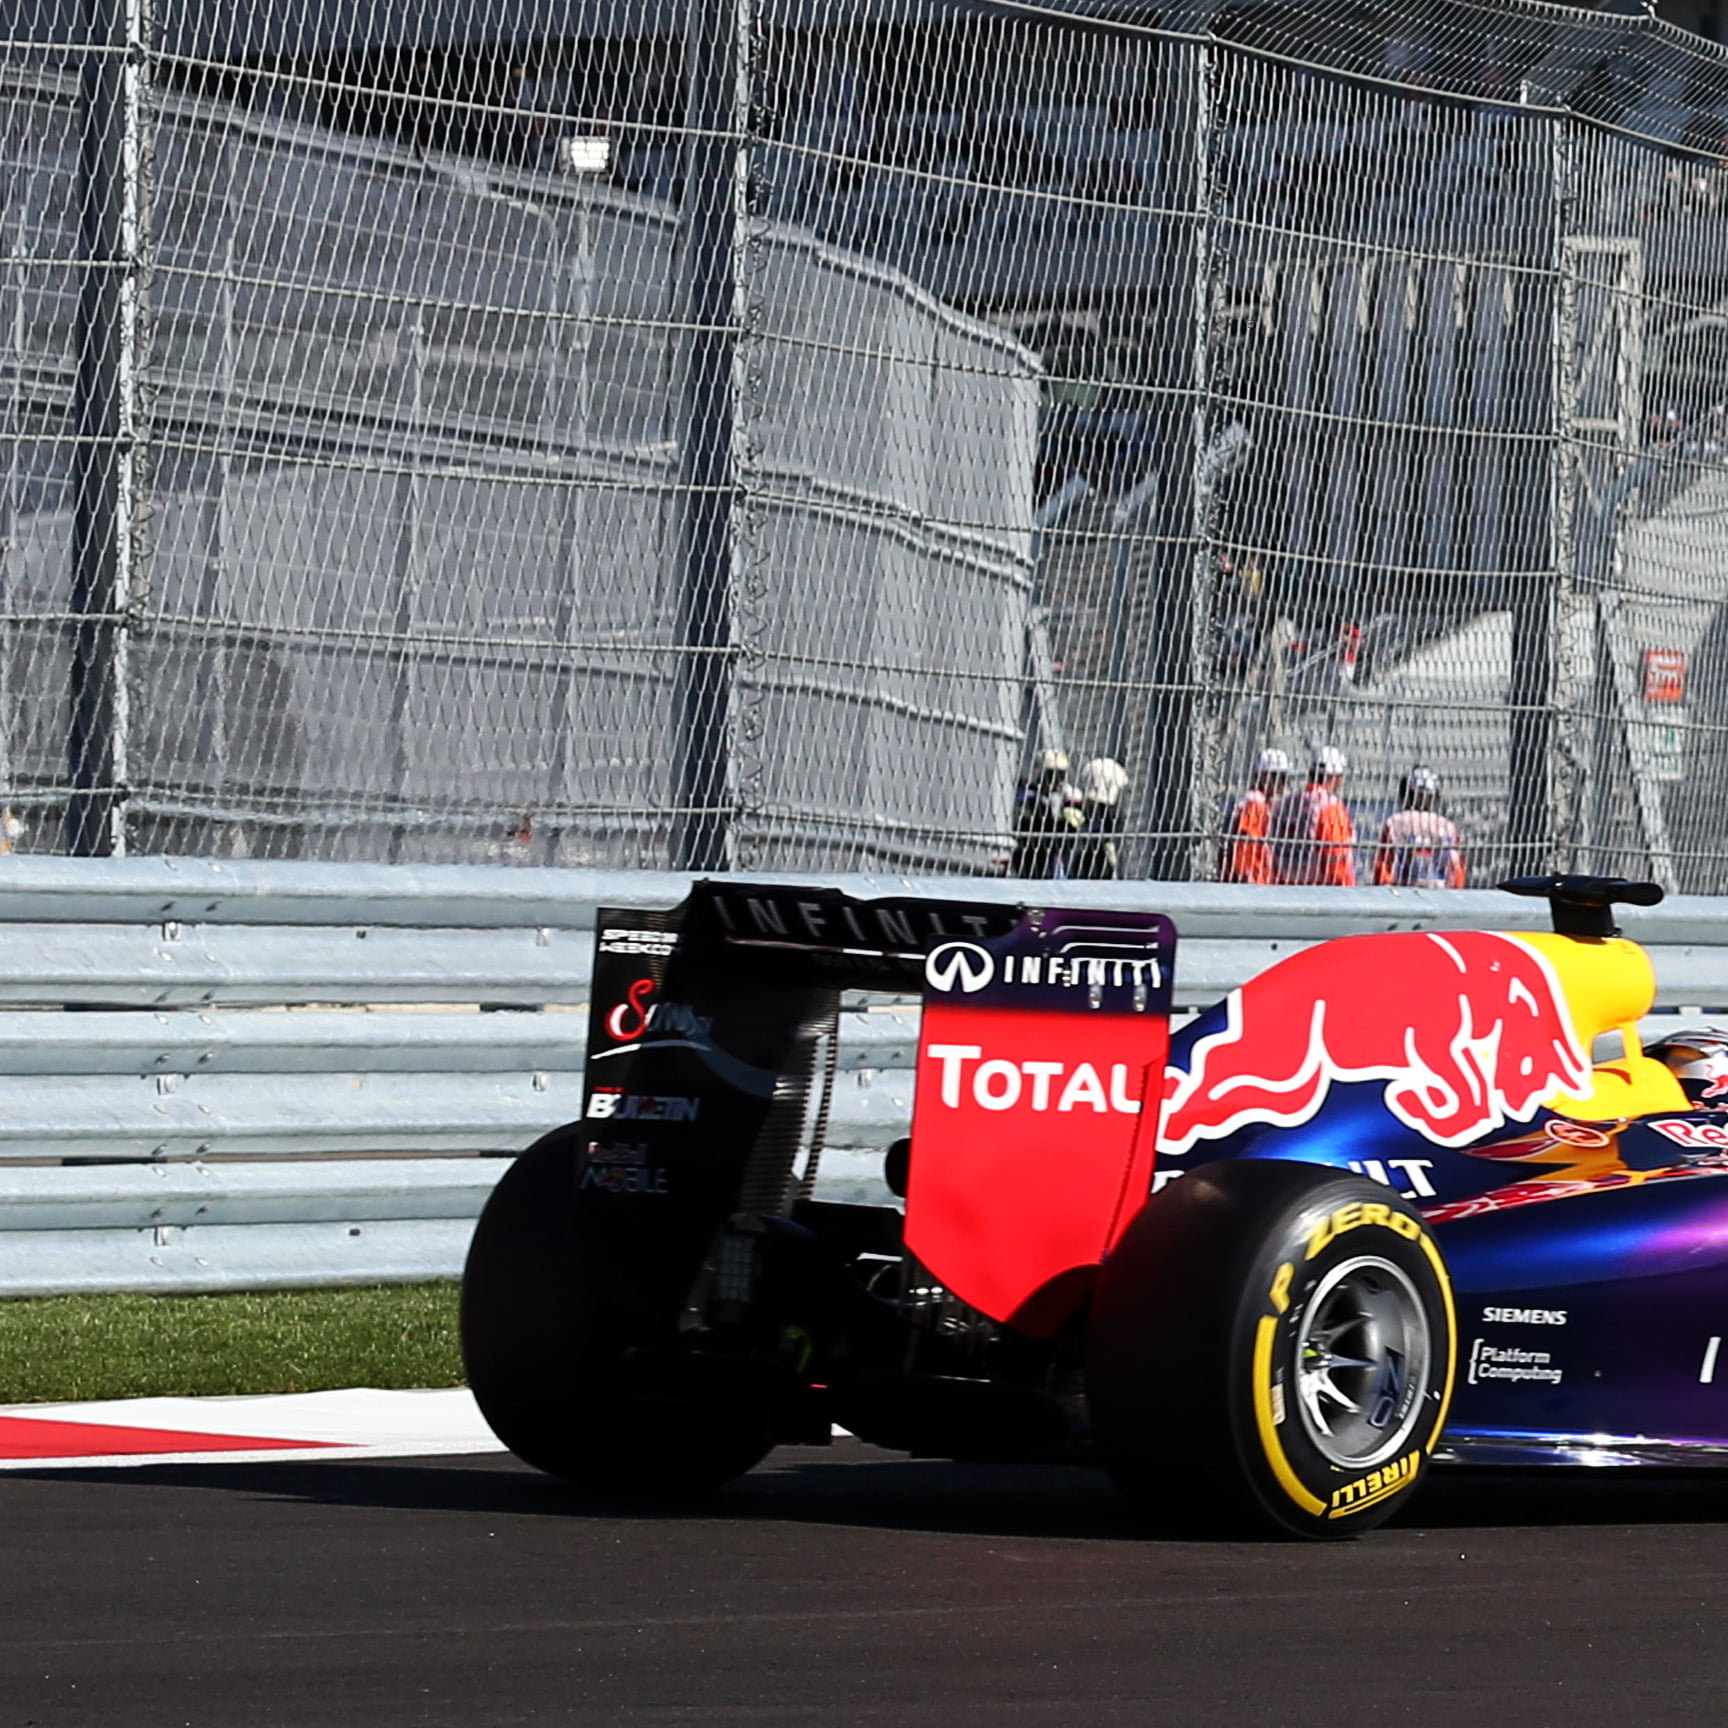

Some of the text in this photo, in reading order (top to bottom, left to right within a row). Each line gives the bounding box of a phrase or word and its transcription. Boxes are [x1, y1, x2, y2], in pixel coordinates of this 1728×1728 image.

[712, 895, 1017, 945] INFINIT
[1003, 955, 1161, 988] INFINITI
[927, 1044, 1142, 1114] TOTAL
[1304, 1202, 1422, 1261] ZERO
[1482, 1306, 1568, 1326] SIEMENS
[1478, 1363, 1563, 1384] Computing
[1480, 1346, 1551, 1364] Platform
[1328, 1449, 1421, 1519] PIRELLI
